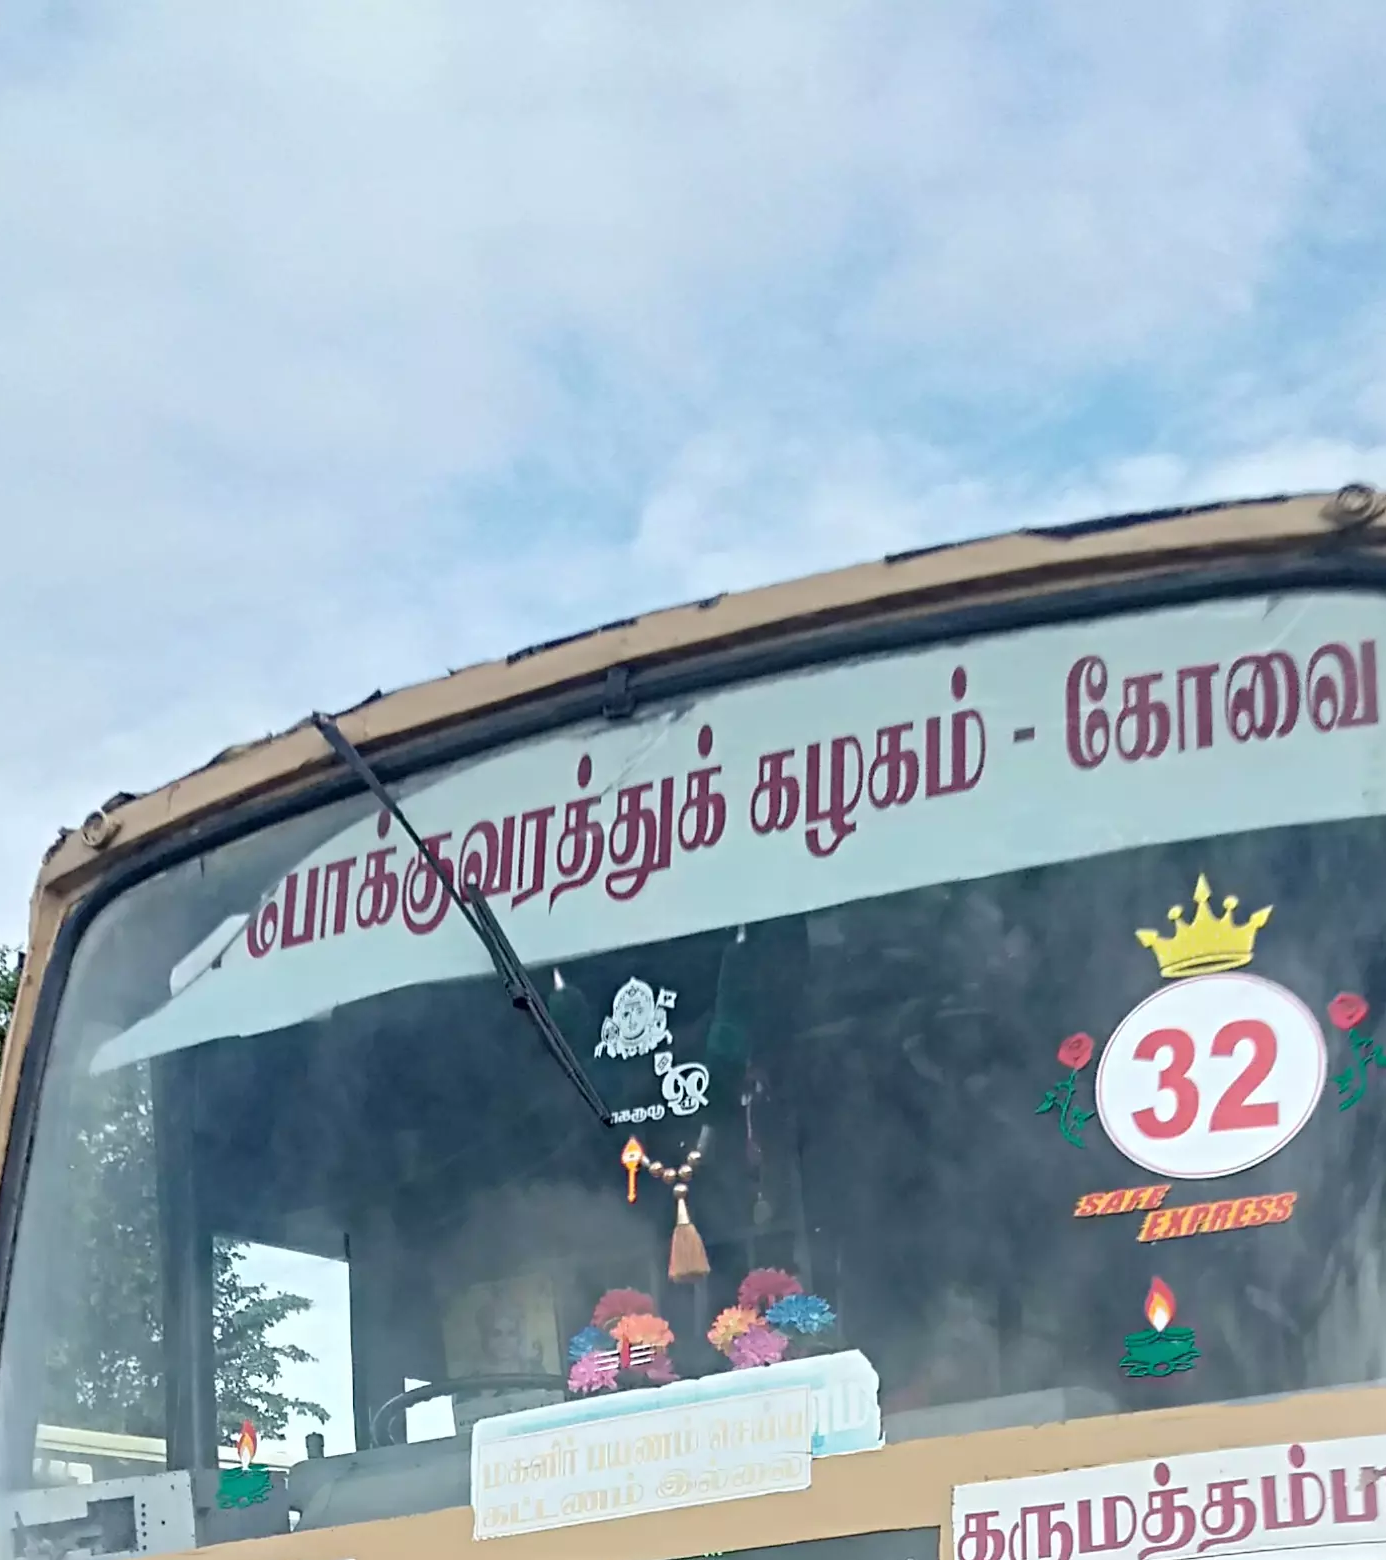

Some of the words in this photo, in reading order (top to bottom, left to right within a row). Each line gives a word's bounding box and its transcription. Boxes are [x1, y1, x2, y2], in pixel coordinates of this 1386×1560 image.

[751, 667, 986, 857] கழகம்
[1066, 640, 1379, 769] கோவை
[1131, 1018, 1280, 1140] 32
[1074, 1184, 1171, 1217] SAFE
[1137, 1192, 1298, 1243] EXPRESS
